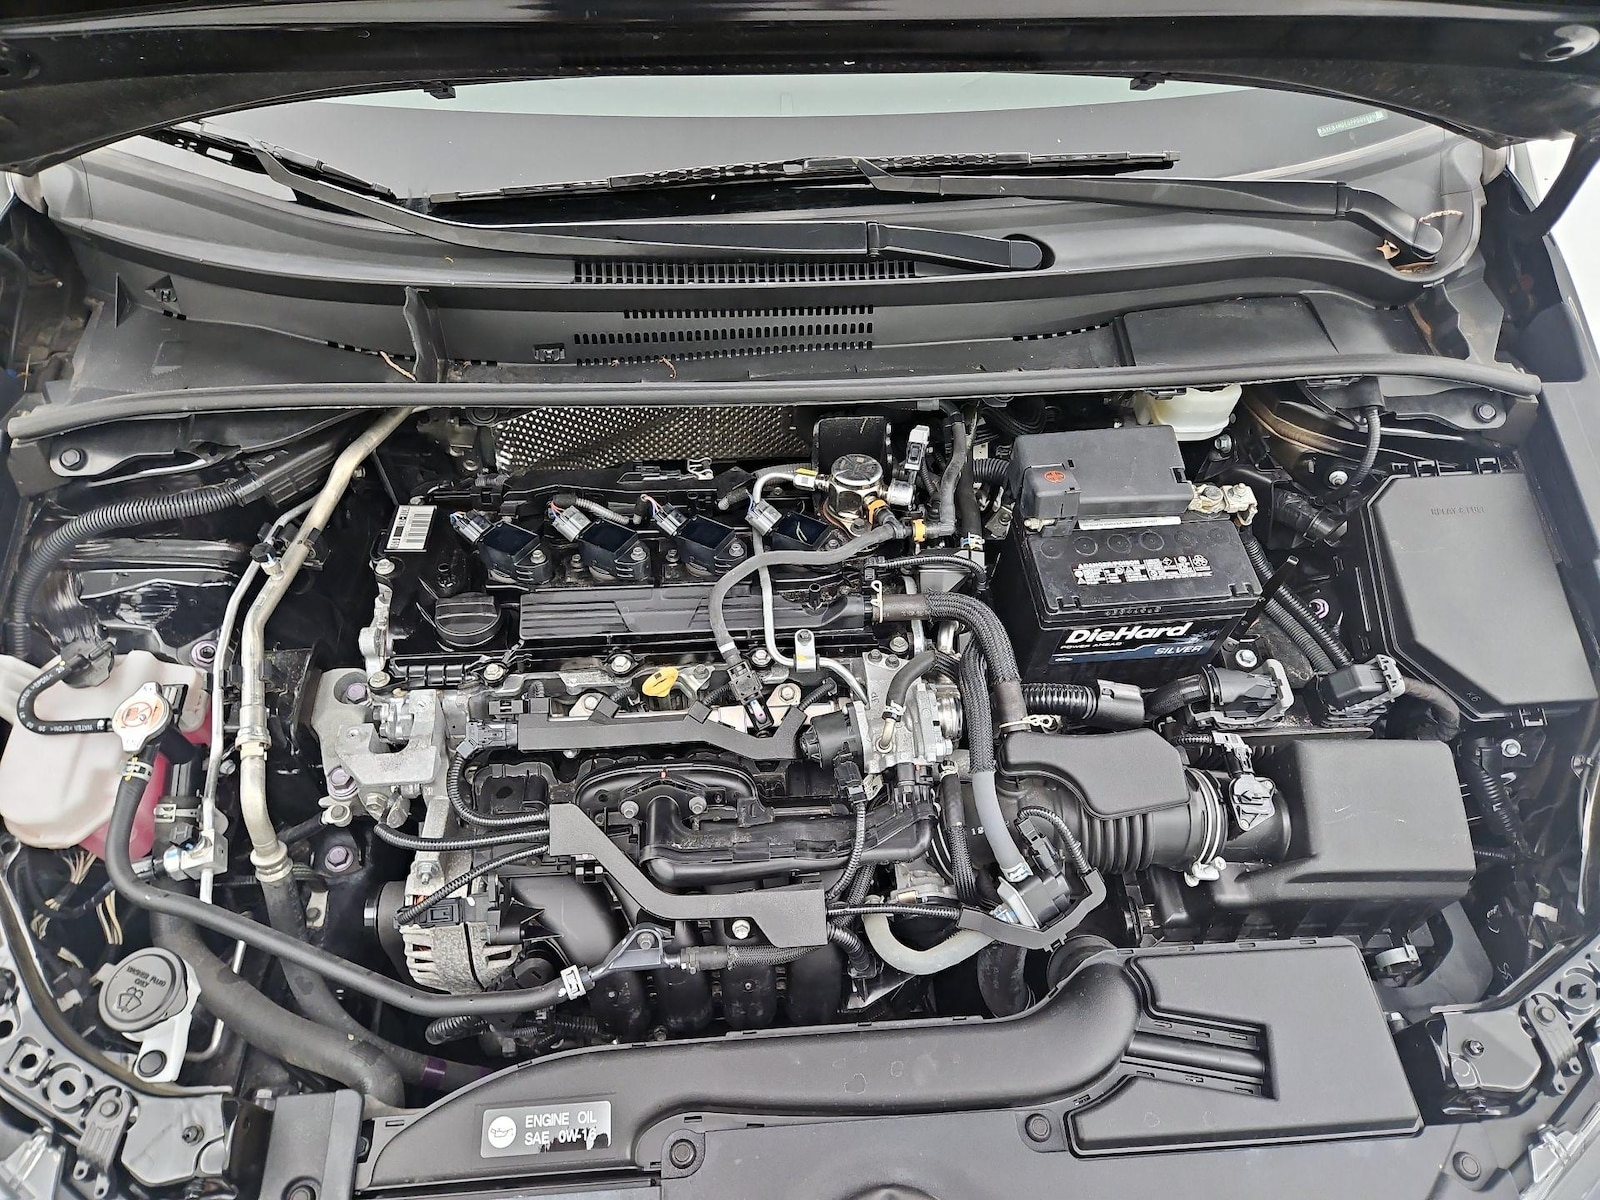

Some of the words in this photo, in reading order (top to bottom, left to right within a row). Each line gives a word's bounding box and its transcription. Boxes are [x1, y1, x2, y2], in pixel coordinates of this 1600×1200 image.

[1065, 621, 1194, 644] DieHard
[1154, 645, 1203, 655] SILVER
[525, 1112, 570, 1128] ENGINE
[577, 1110, 597, 1124] OIL
[524, 1131, 550, 1146] SAE
[558, 1127, 597, 1144] 0W-16
